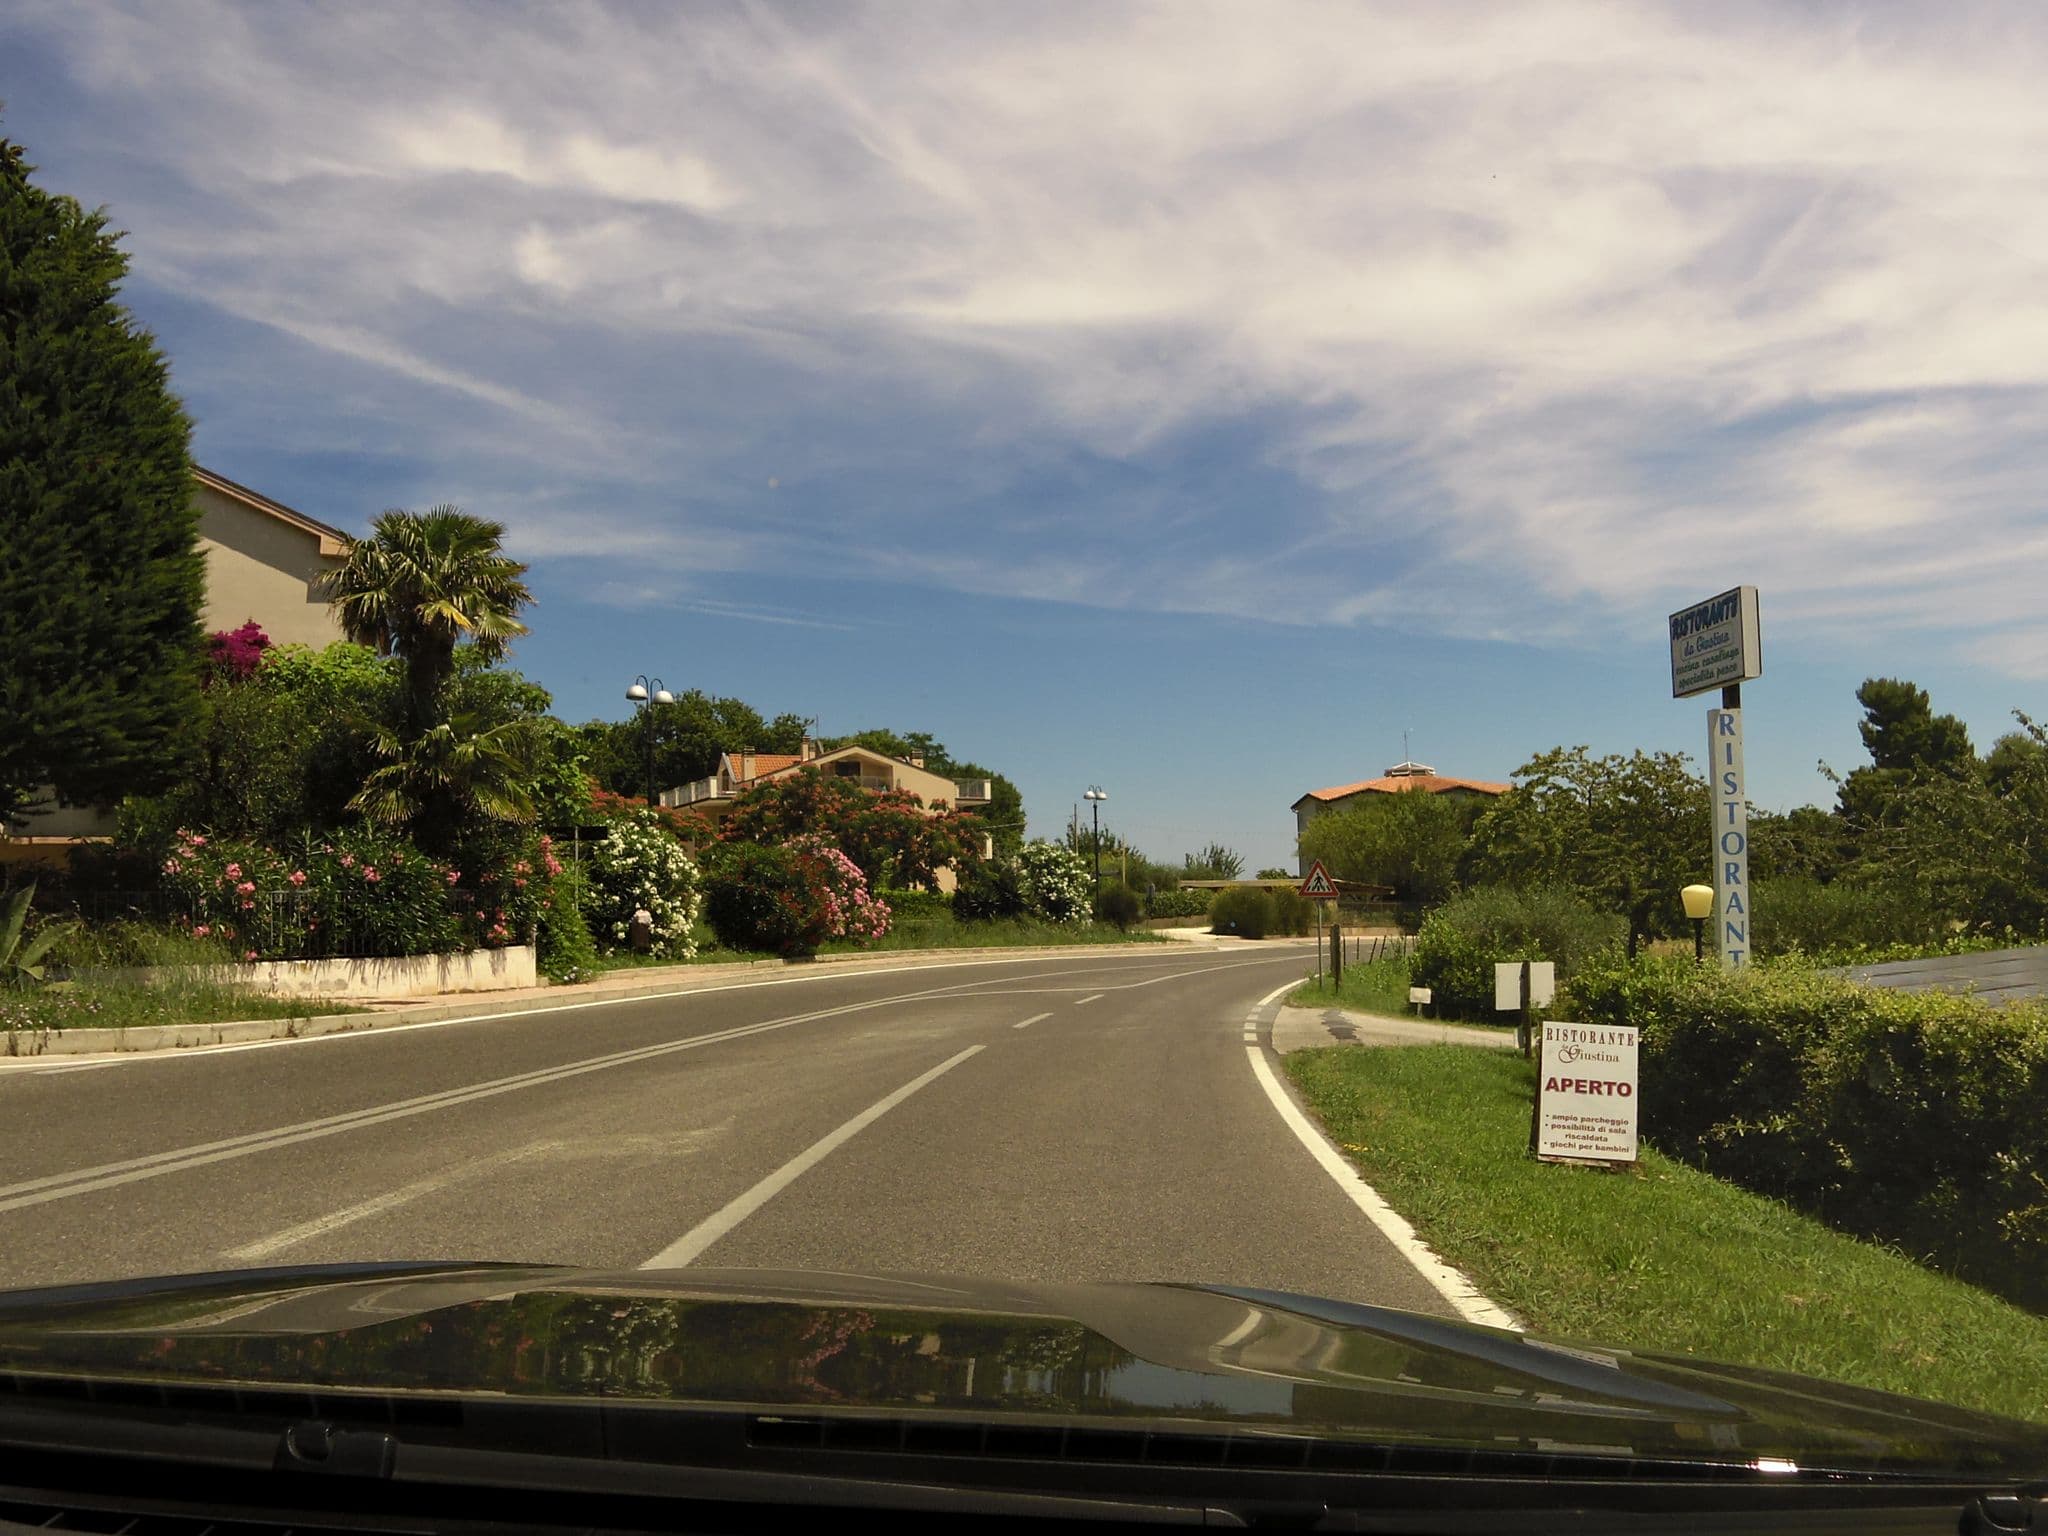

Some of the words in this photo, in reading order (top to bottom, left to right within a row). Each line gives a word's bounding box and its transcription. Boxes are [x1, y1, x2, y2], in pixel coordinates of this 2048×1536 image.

[1671, 593, 1738, 640] RISTORANTE
[1546, 1027, 1635, 1047] RISTORANTE
[1558, 1044, 1620, 1064] Giustina
[1545, 1077, 1632, 1097] APERTO
[1551, 1123, 1595, 1132] possibilità
[1552, 1114, 1578, 1122] ampio
[1580, 1117, 1629, 1126] parcheggio
[1565, 1133, 1608, 1142] riscaldata
[1550, 1141, 1577, 1150] giochi
[1578, 1144, 1593, 1152] per
[1595, 1144, 1630, 1153] bambini
